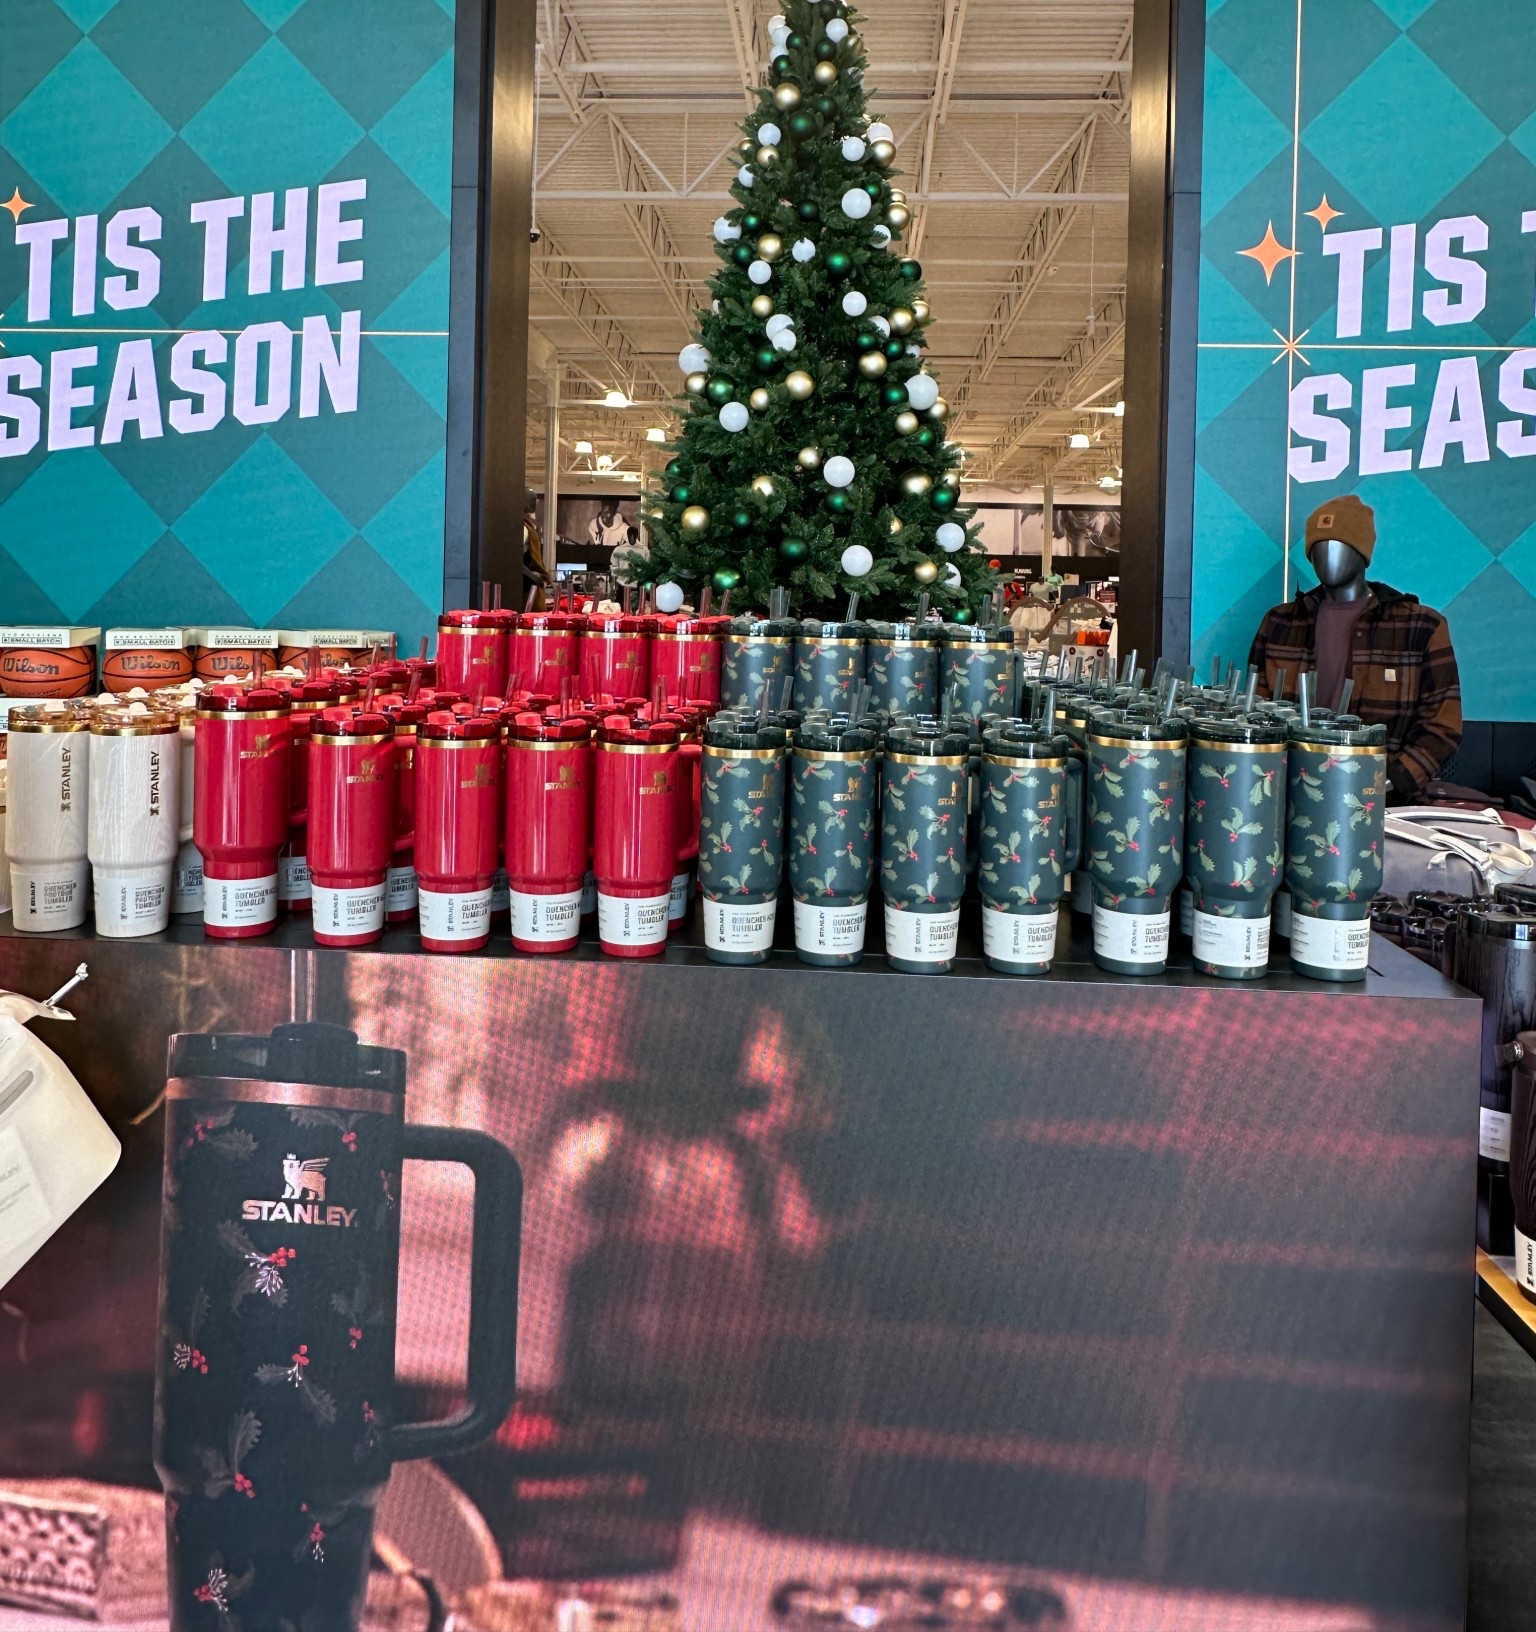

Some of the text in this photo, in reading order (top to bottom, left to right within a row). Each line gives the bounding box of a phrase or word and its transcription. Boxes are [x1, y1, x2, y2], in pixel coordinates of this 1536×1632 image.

[15, 178, 367, 323] TIS THE
[1322, 215, 1489, 339] TIS
[0, 310, 362, 458] SEASON
[2, 657, 60, 676] Wilson
[120, 654, 181, 671] Wilson
[61, 747, 71, 801] STANLEY
[150, 750, 160, 805] STANLEY
[242, 1199, 358, 1228] STANLEY
